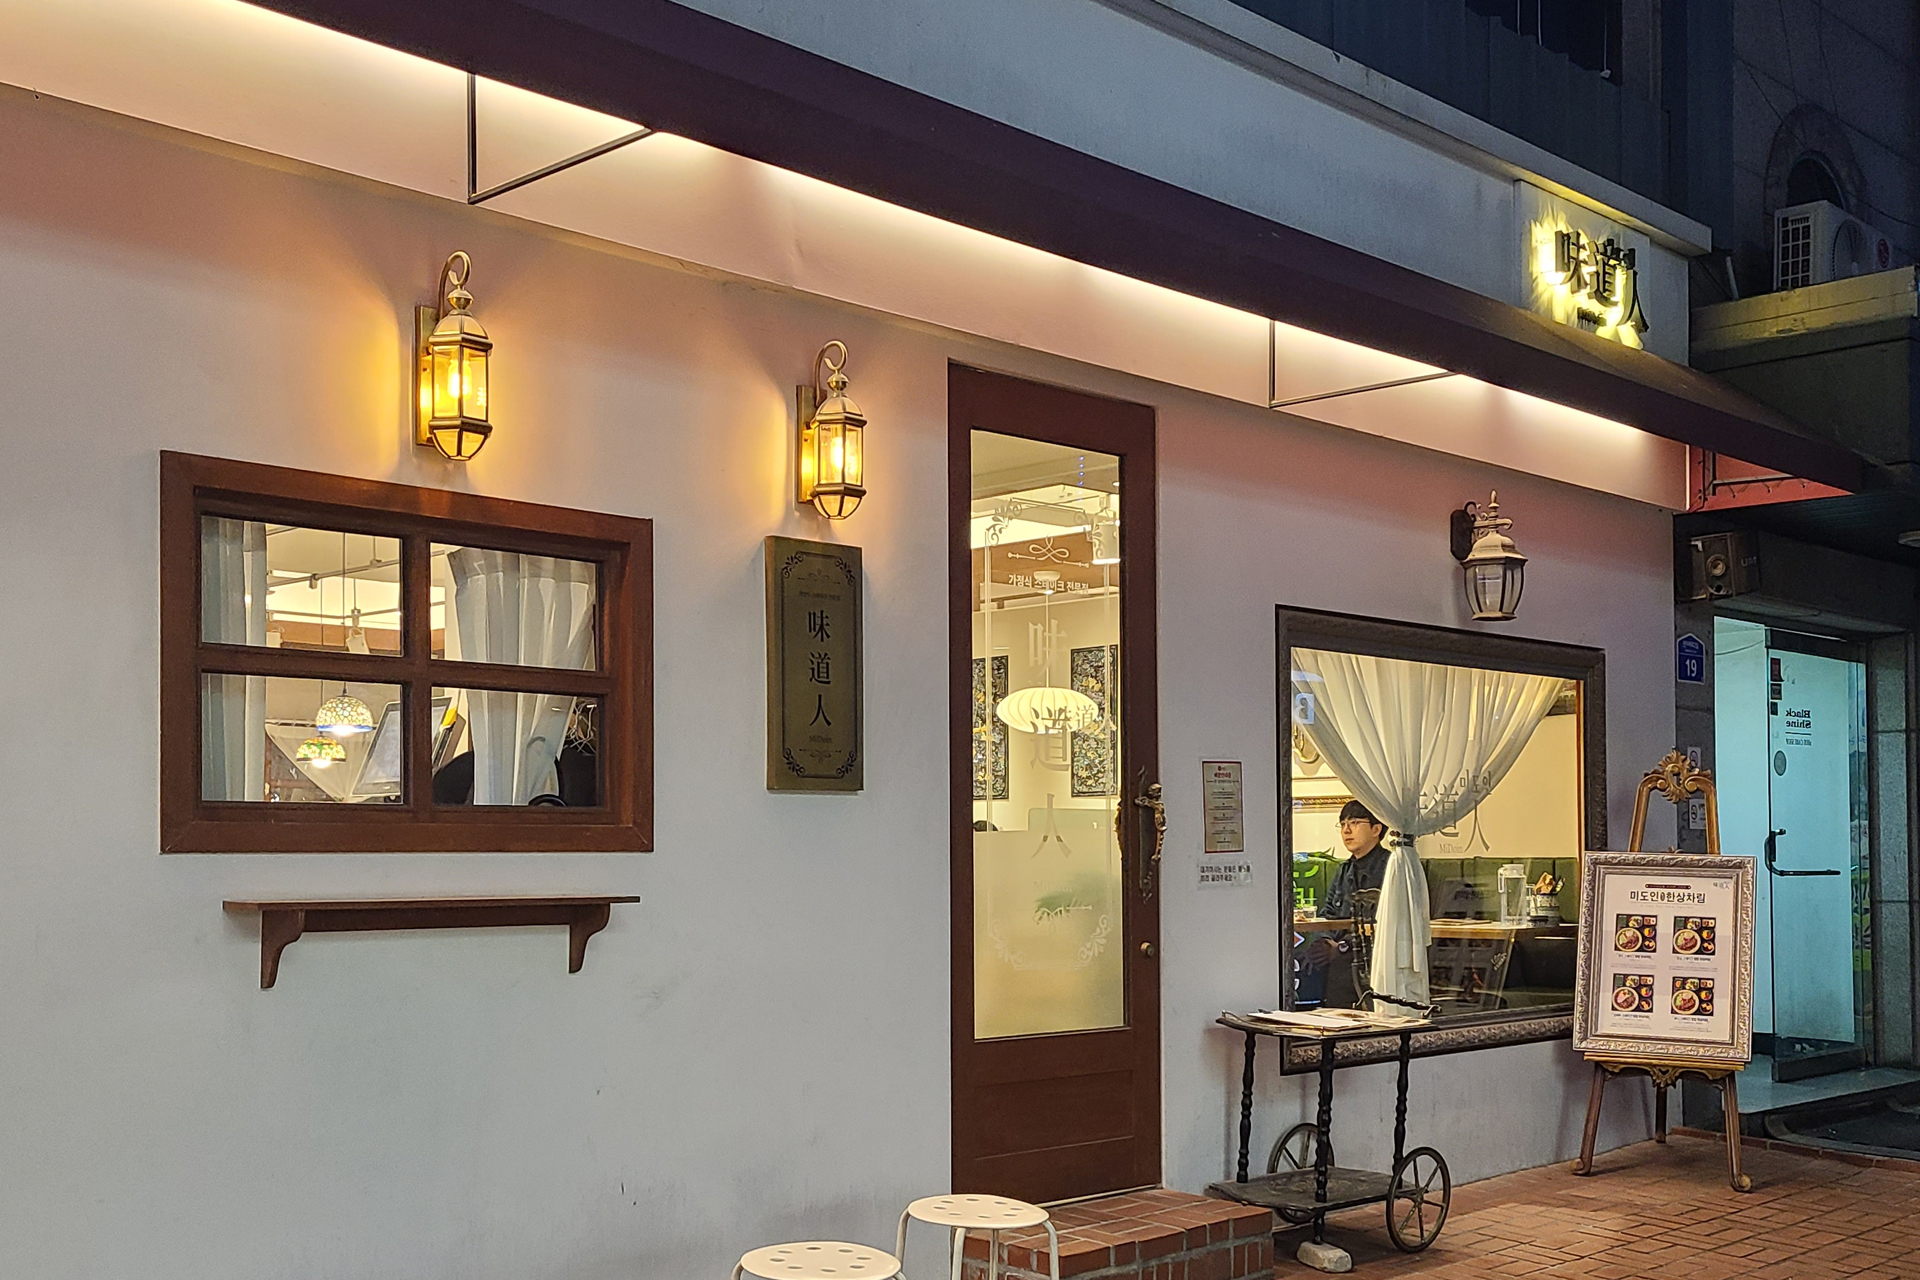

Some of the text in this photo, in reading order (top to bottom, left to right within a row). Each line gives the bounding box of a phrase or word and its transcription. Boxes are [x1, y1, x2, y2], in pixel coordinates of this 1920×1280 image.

[1555, 230, 1649, 333] 味道人
[1008, 573, 1032, 588] 가정식
[808, 610, 832, 728] 味道人
[1685, 659, 1697, 677] 19
